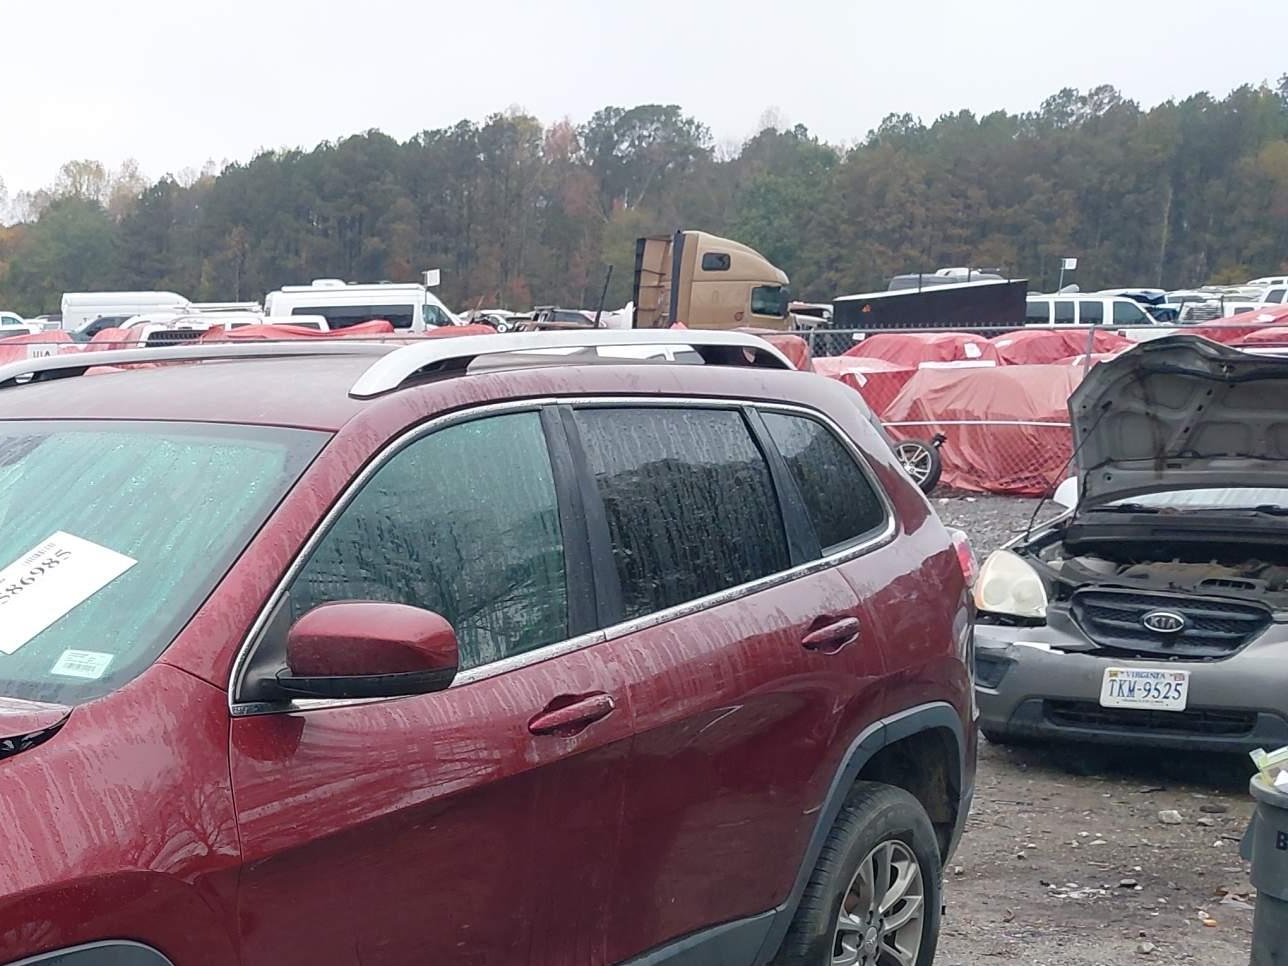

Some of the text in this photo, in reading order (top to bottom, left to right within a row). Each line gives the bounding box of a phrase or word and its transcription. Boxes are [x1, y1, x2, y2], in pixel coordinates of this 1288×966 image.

[1149, 615, 1178, 629] KIA
[1125, 670, 1167, 680] VIRGINIA
[1108, 679, 1184, 701] TKM-9525
